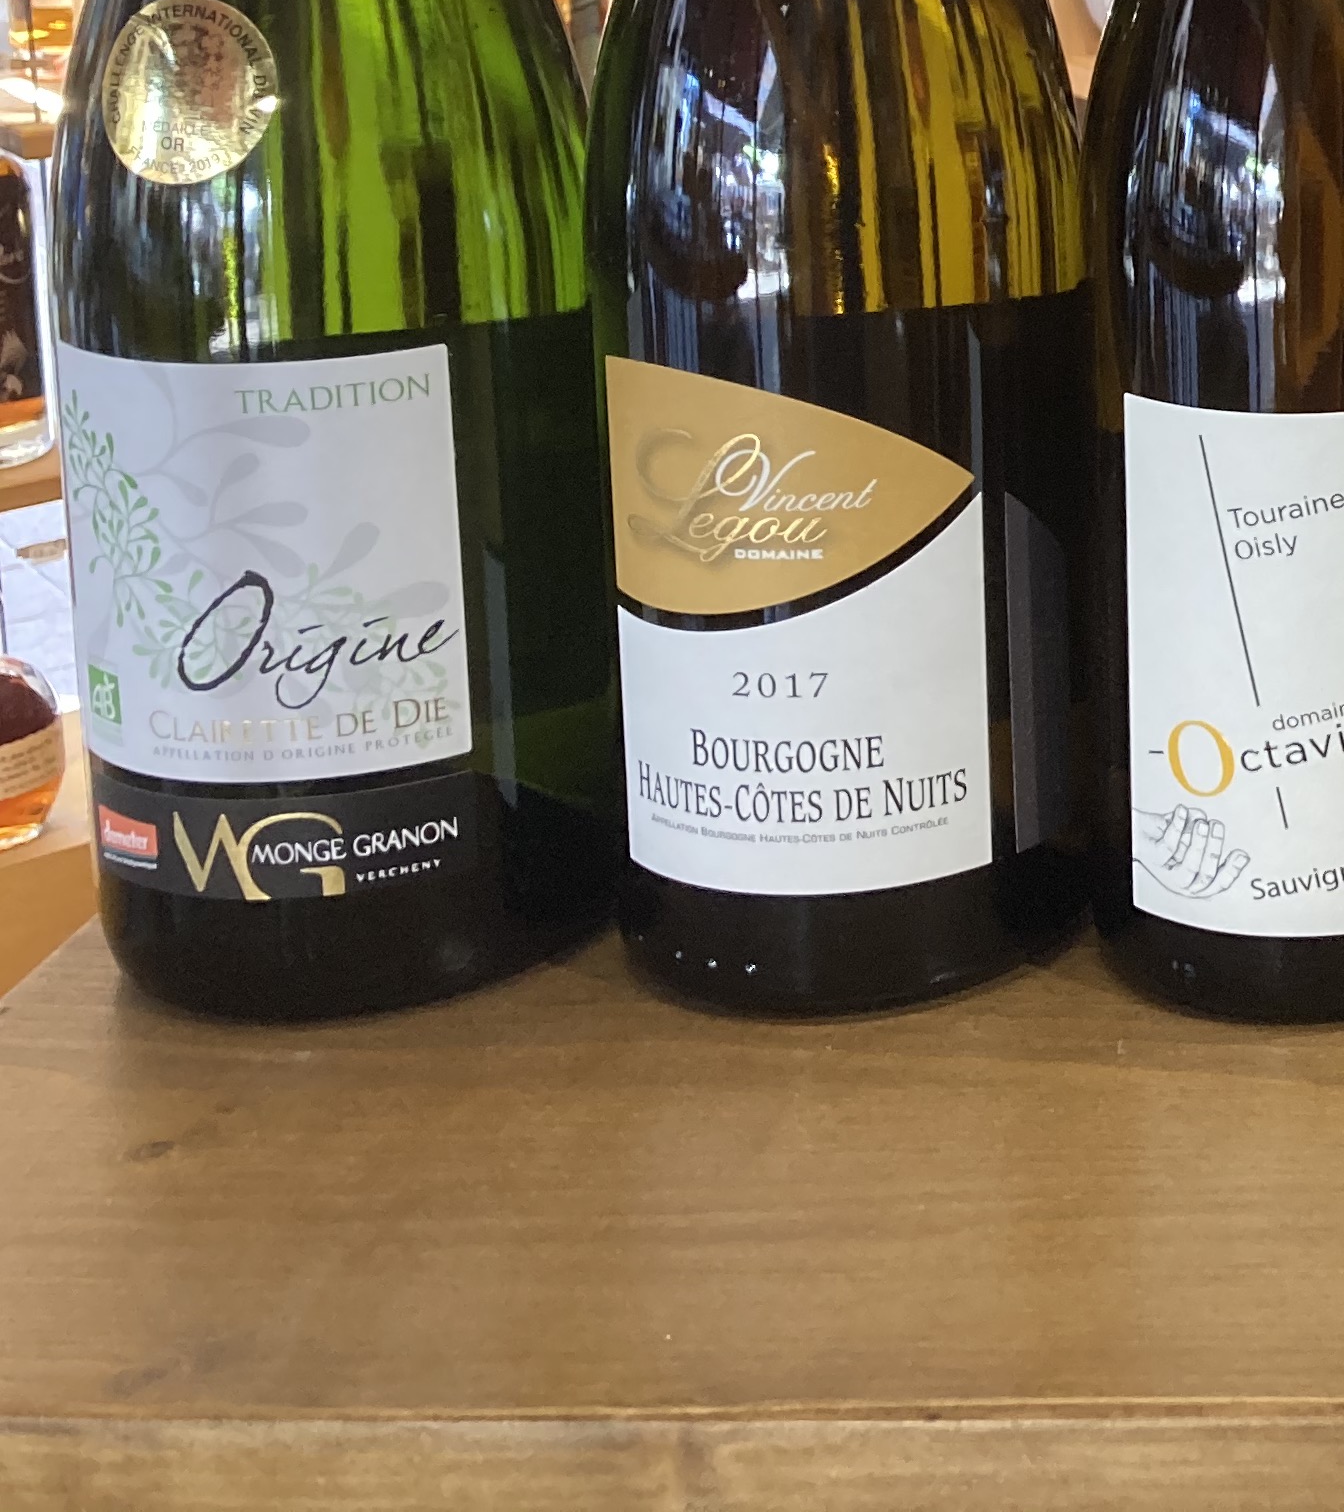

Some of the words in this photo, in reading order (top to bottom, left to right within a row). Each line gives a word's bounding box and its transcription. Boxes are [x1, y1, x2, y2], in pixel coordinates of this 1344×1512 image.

[147, 3, 263, 66] INTERNATIONAL
[161, 136, 184, 152] OR
[234, 372, 432, 416] TRADITION
[715, 448, 877, 513] Vincent
[734, 548, 824, 560] DOMAINE
[1234, 532, 1298, 561] Oisly
[178, 570, 460, 710] Origine
[731, 671, 830, 699] 2017
[336, 710, 376, 738] DE
[393, 696, 450, 730] DIE
[152, 745, 255, 763] APPELLATION
[690, 727, 886, 774] BOURGOGNE
[637, 759, 824, 824] HAUTES-CÔTES
[833, 788, 874, 822] DE
[882, 767, 969, 817] NUITS
[251, 837, 347, 866] MONGE
[352, 816, 460, 858] GRANON
[651, 813, 699, 836] APPELLATION
[700, 826, 757, 843] BOURGOGNE
[838, 832, 853, 841] DE
[855, 827, 888, 840] NUITS
[356, 858, 443, 884] VERCHENY
